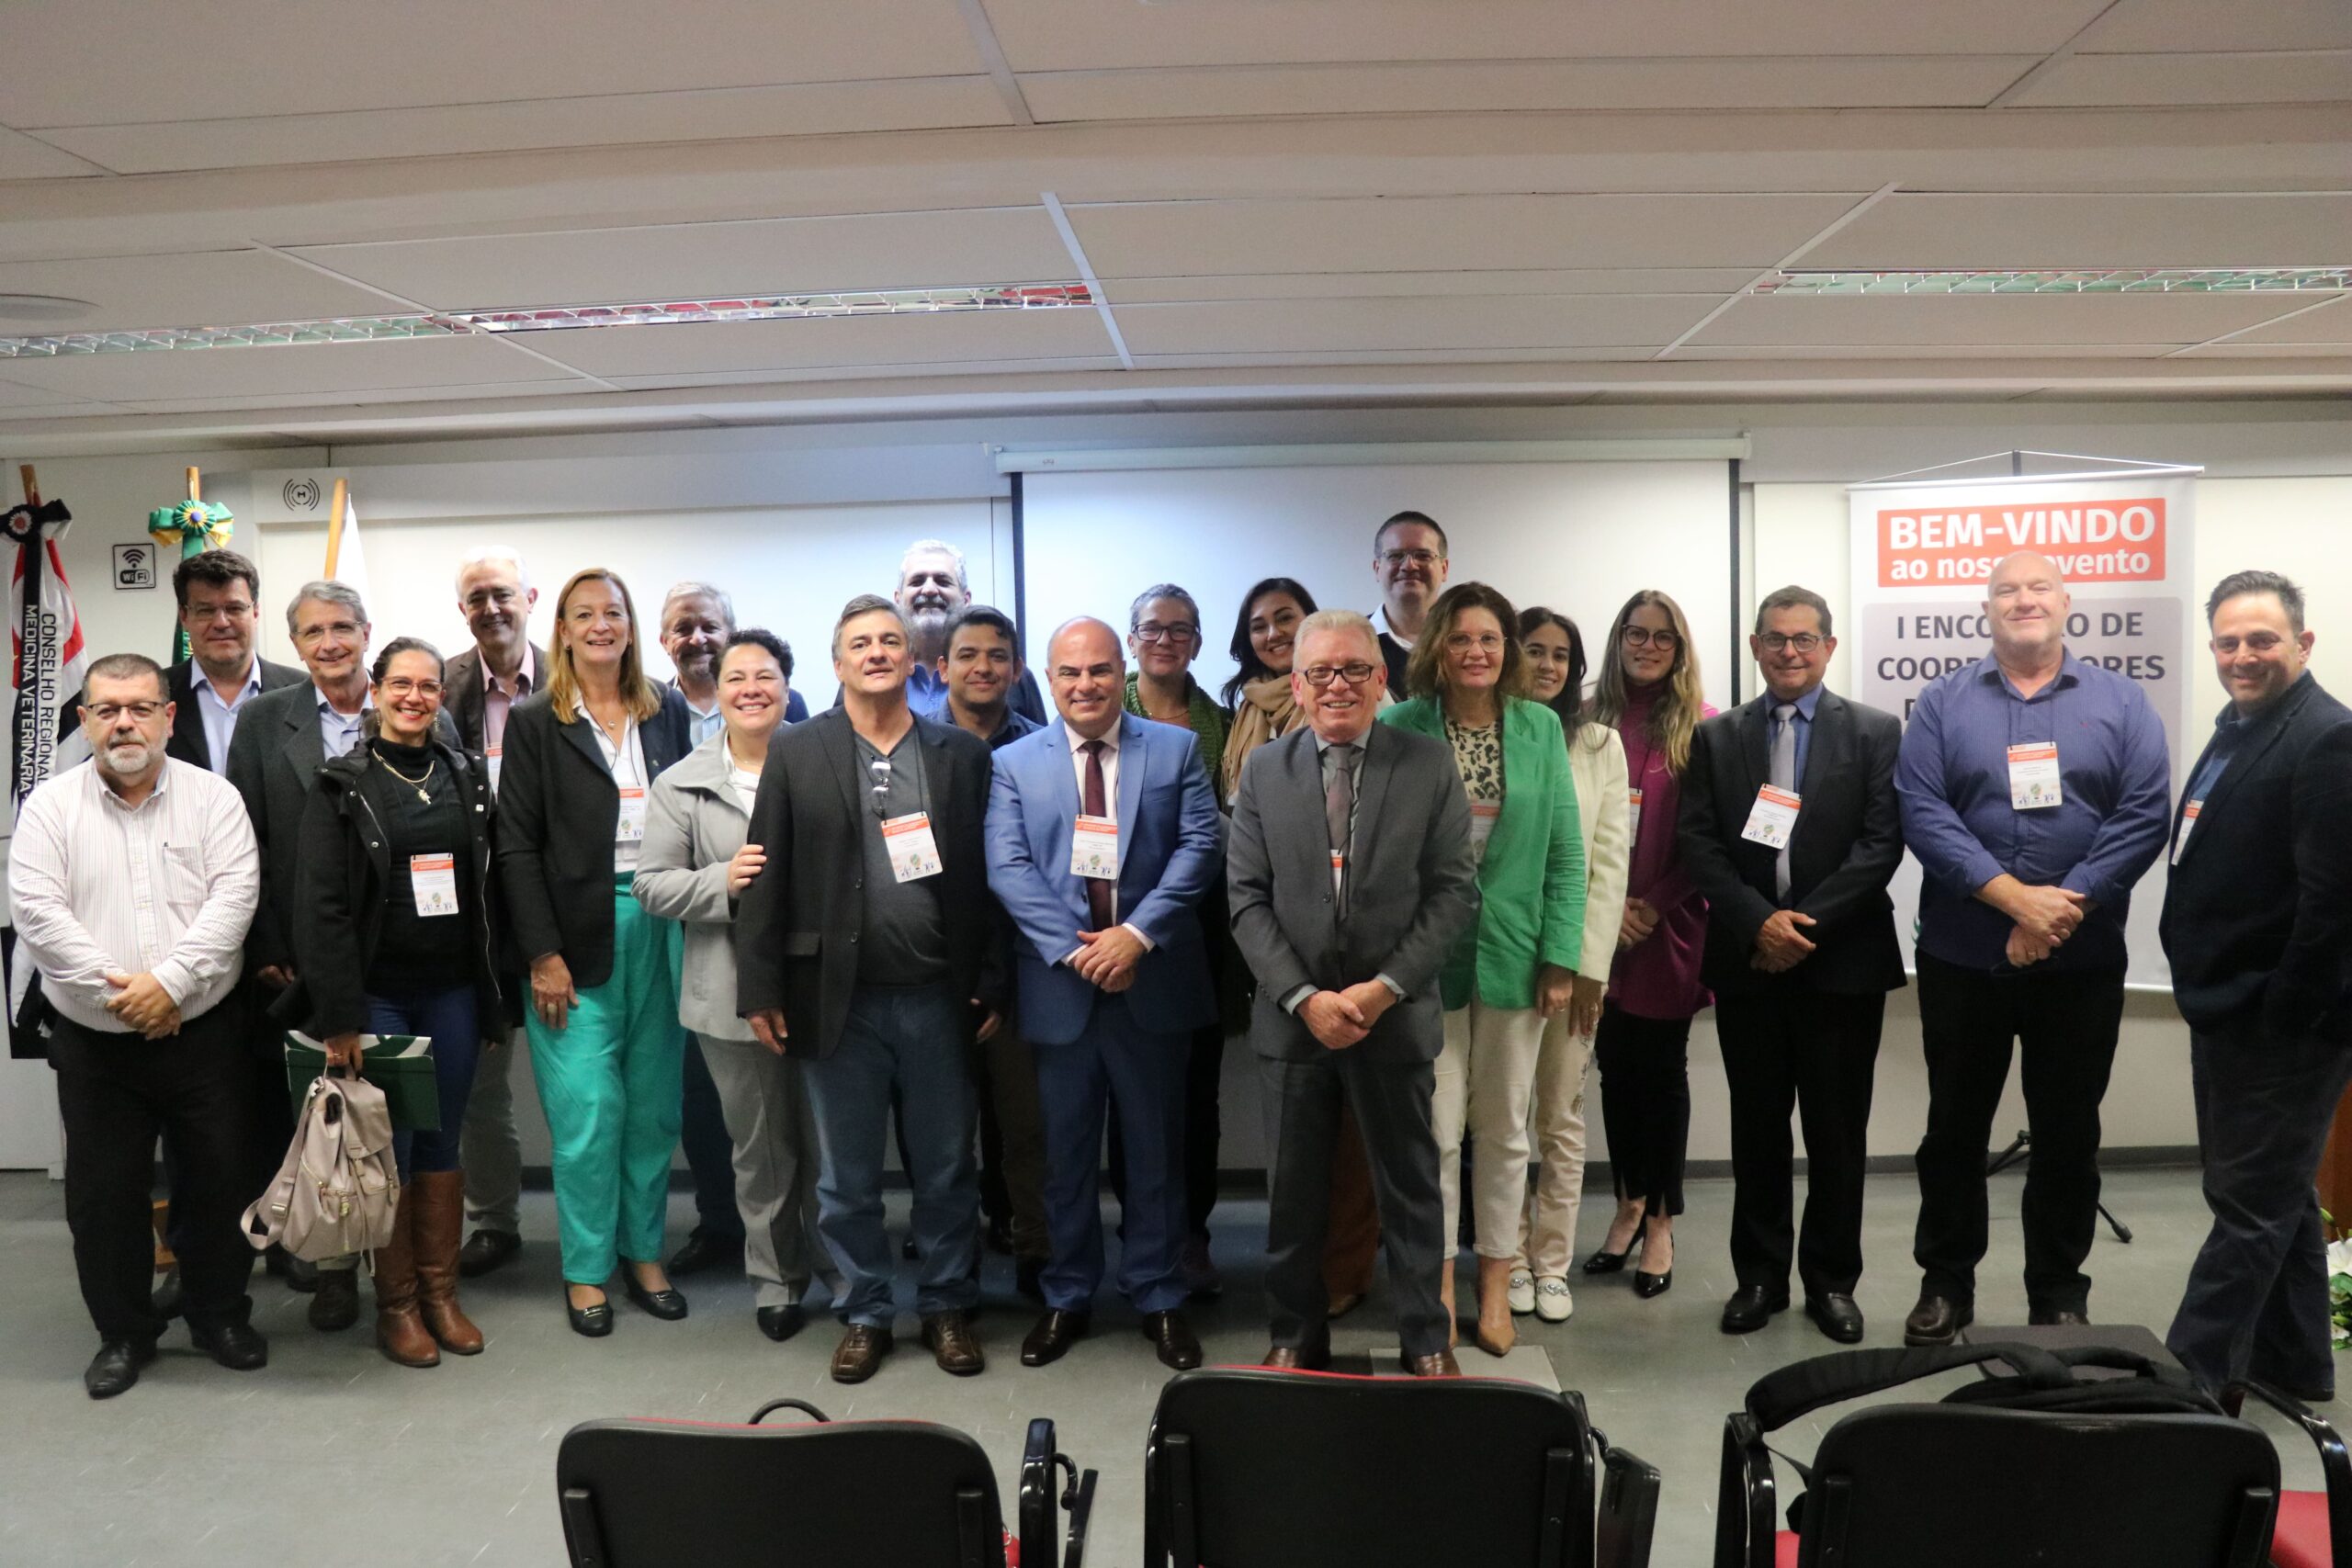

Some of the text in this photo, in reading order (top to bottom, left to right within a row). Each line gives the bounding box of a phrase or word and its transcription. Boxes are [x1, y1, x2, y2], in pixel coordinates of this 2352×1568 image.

[1890, 506, 2155, 549] BEM-VINDO
[1891, 548, 2151, 580] ao nos vento
[22, 604, 38, 682] MEDICINA
[1897, 616, 1904, 638] I
[2101, 612, 2143, 637] DE
[37, 613, 57, 785] CONSELHO REGIONAL
